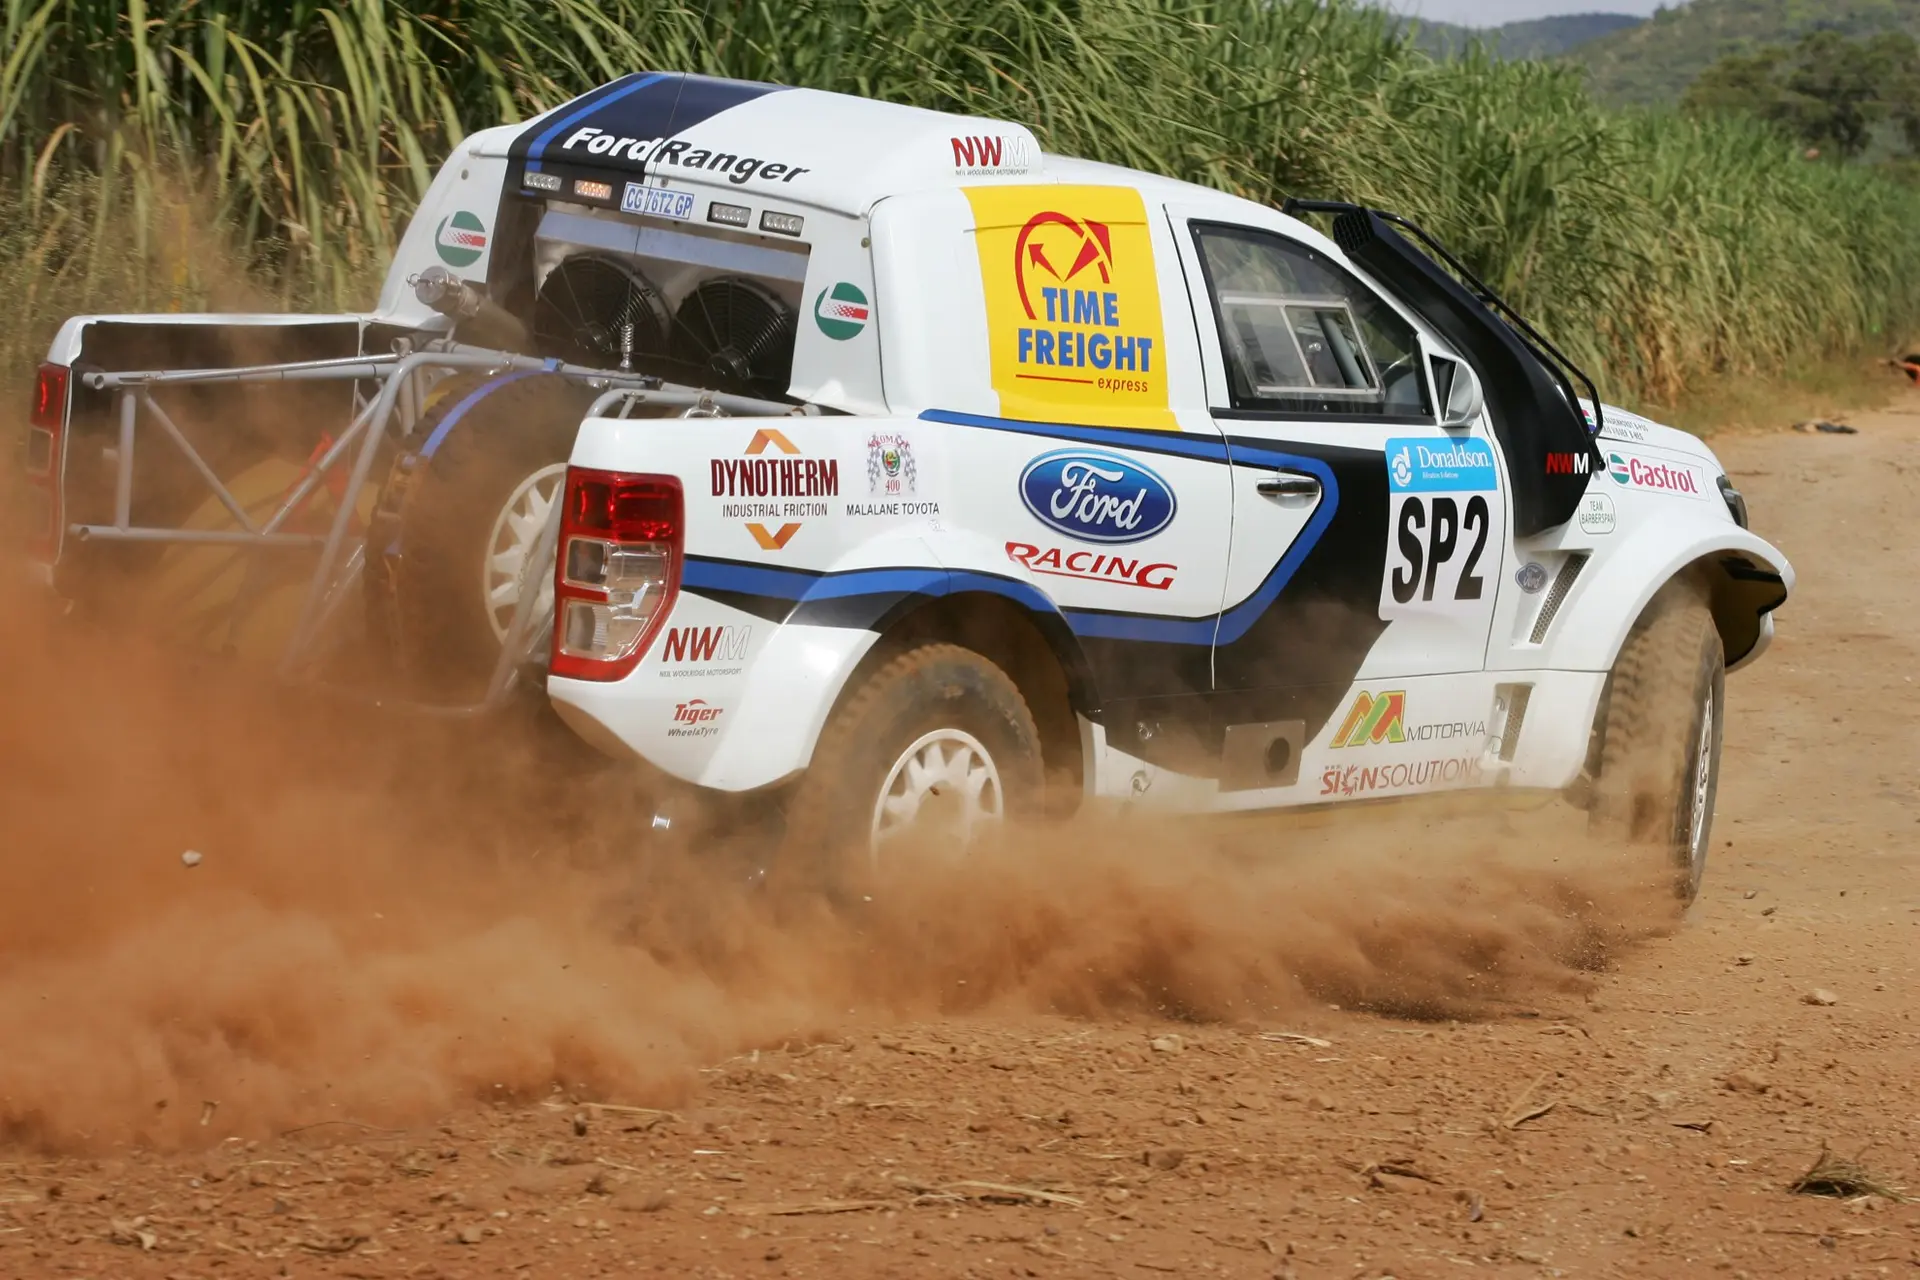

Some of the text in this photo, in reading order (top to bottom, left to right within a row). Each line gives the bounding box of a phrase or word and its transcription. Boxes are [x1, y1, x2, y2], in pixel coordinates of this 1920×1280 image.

[562, 127, 811, 185] Ford Ranger
[951, 135, 1029, 167] NWM
[626, 187, 643, 209] CG
[675, 195, 692, 216] GP
[1042, 287, 1120, 327] TIME
[1018, 328, 1153, 372] FREIGHT
[1098, 377, 1148, 393] express
[1416, 444, 1489, 468] Donaldson
[1546, 452, 1589, 474] NWM
[710, 459, 839, 497] DYNOTHERM
[885, 479, 901, 492] 400
[1629, 458, 1699, 494] Castrol
[722, 503, 828, 518] INDUSTRIAL FRICTION
[846, 502, 940, 516] MALALANE TOYOTA
[1050, 461, 1148, 530] Ford
[1590, 500, 1604, 512] TEAM
[1392, 495, 1490, 604] SP2
[1005, 541, 1178, 590] RACING
[662, 625, 752, 662] NWM
[674, 702, 723, 726] Tiger
[1406, 720, 1486, 742] MOTORVIA
